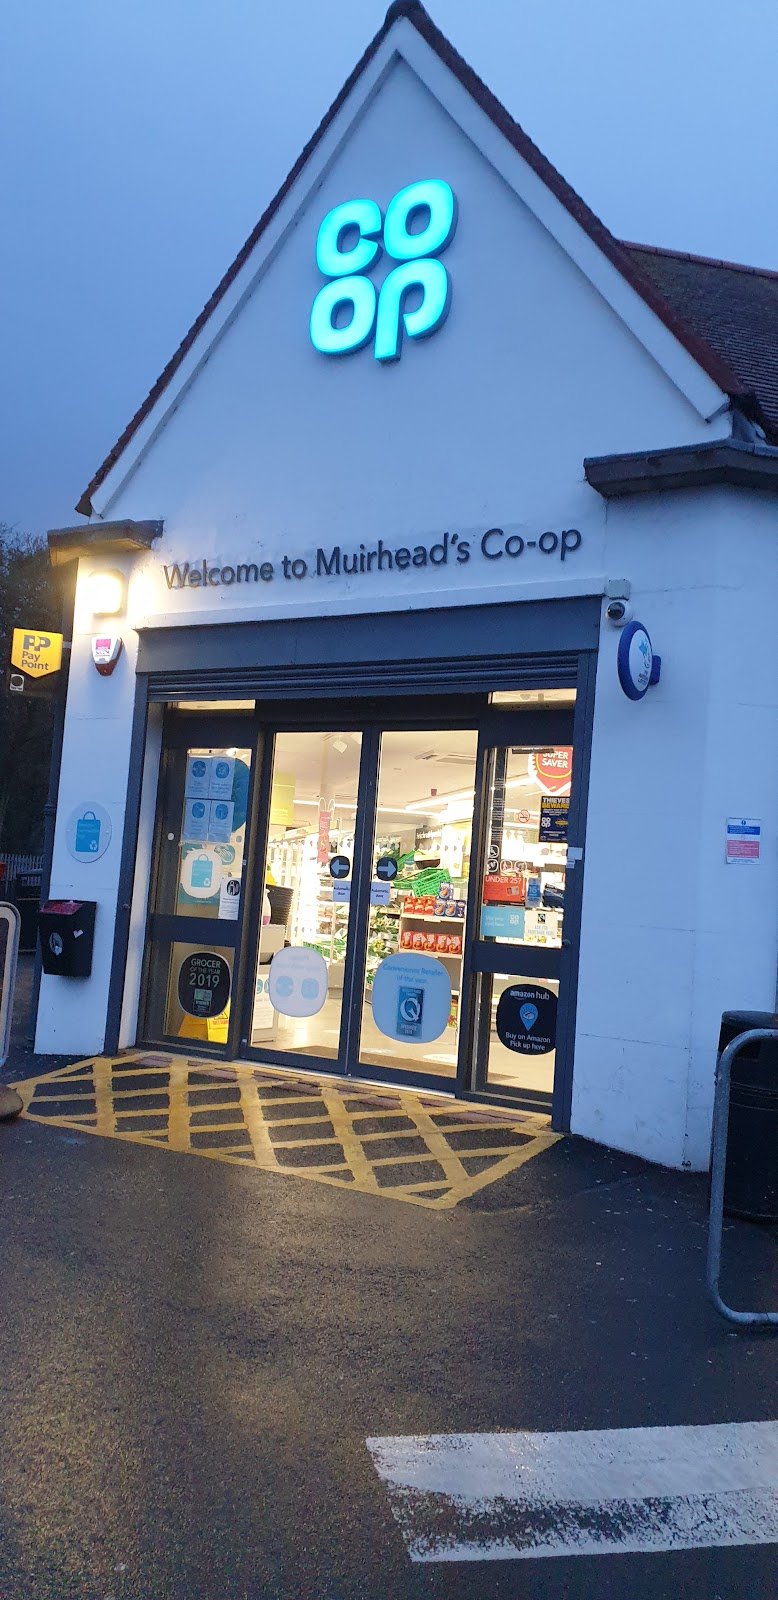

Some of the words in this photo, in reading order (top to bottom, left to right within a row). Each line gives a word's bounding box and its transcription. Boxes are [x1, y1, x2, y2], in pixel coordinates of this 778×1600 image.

[162, 559, 274, 590] Welcome
[280, 555, 307, 579] to
[315, 532, 471, 577] Muirhead's
[480, 527, 582, 561] Co-op
[22, 651, 41, 662] Pay
[21, 660, 49, 671] Point
[541, 759, 568, 768] SAVER
[485, 876, 509, 884] UNDER
[191, 959, 221, 969] GROCER
[189, 973, 220, 988] 2019
[510, 990, 535, 998] amazon
[536, 991, 550, 1000] hub
[505, 1032, 517, 1040] Buy
[526, 1035, 551, 1043] Amazon
